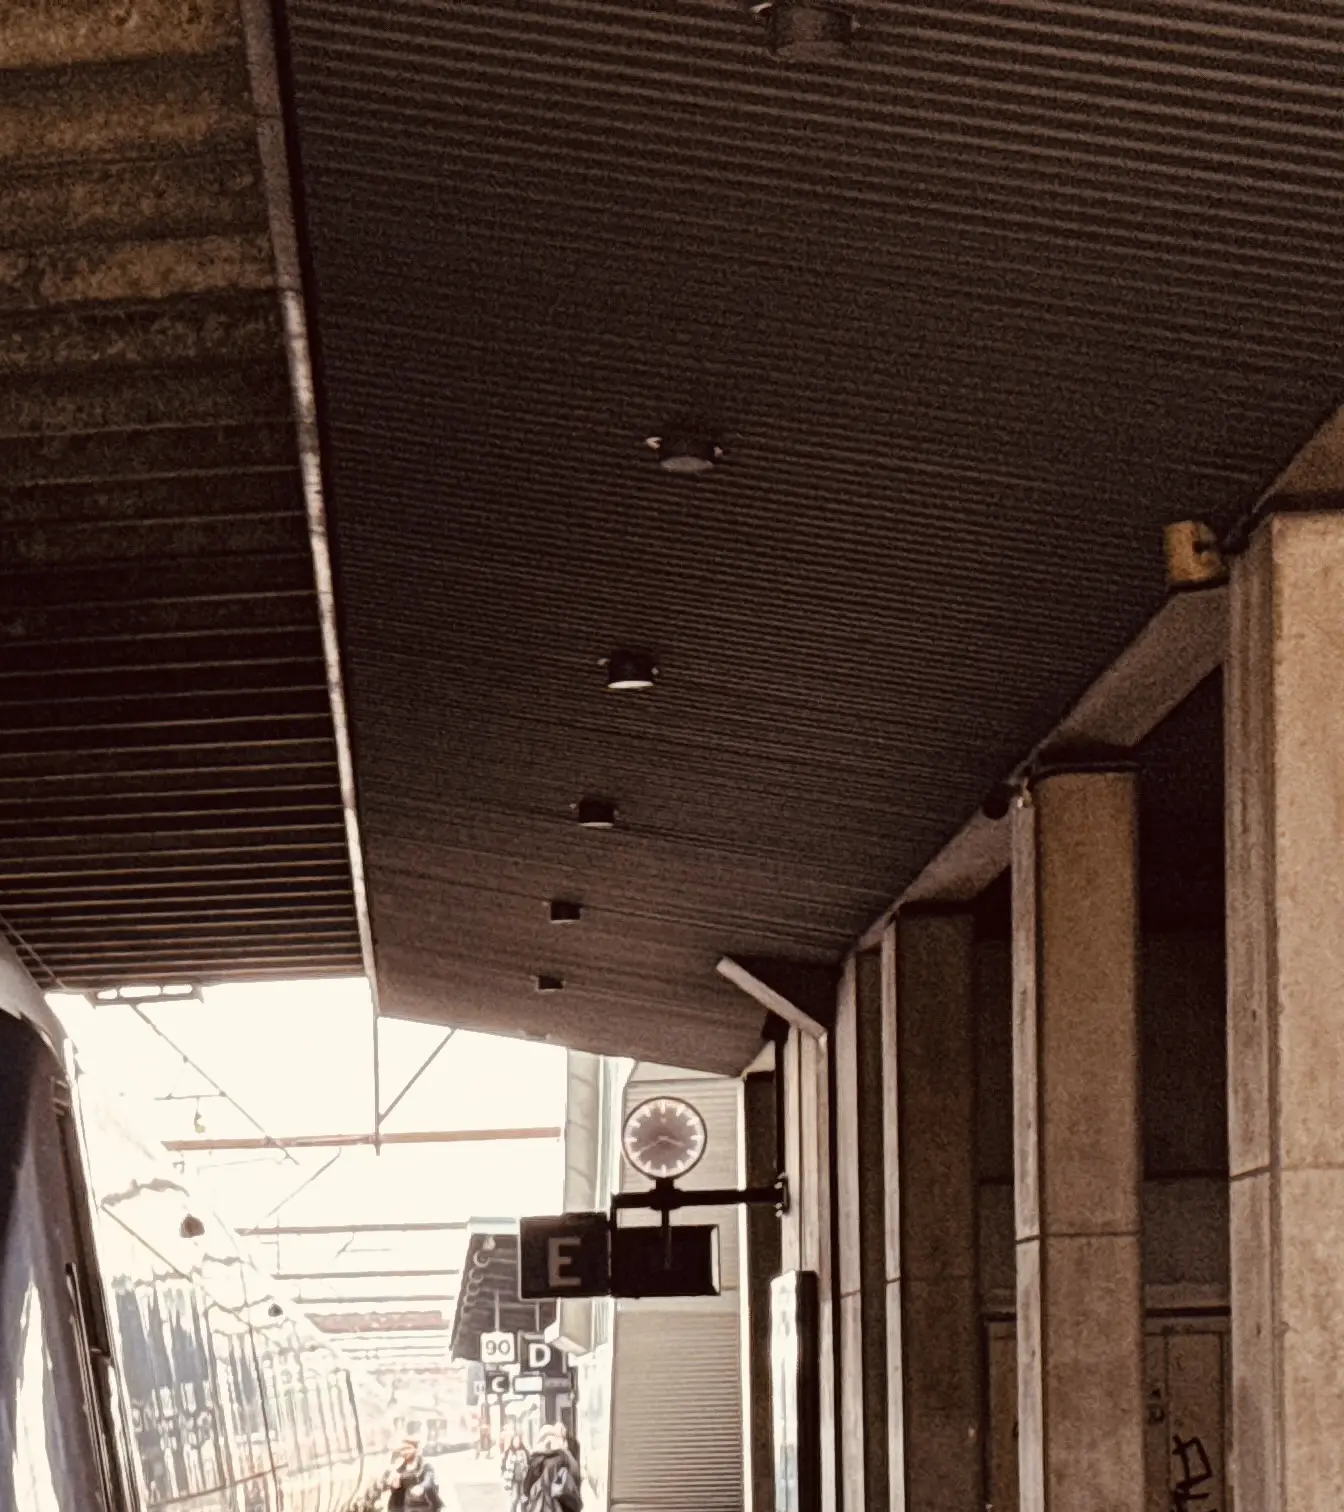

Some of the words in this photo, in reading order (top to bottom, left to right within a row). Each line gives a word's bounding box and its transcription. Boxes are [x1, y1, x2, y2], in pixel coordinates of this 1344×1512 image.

[548, 1237, 581, 1287] E
[486, 1340, 510, 1355] 90
[529, 1343, 551, 1368] D
[491, 1376, 505, 1392] C
